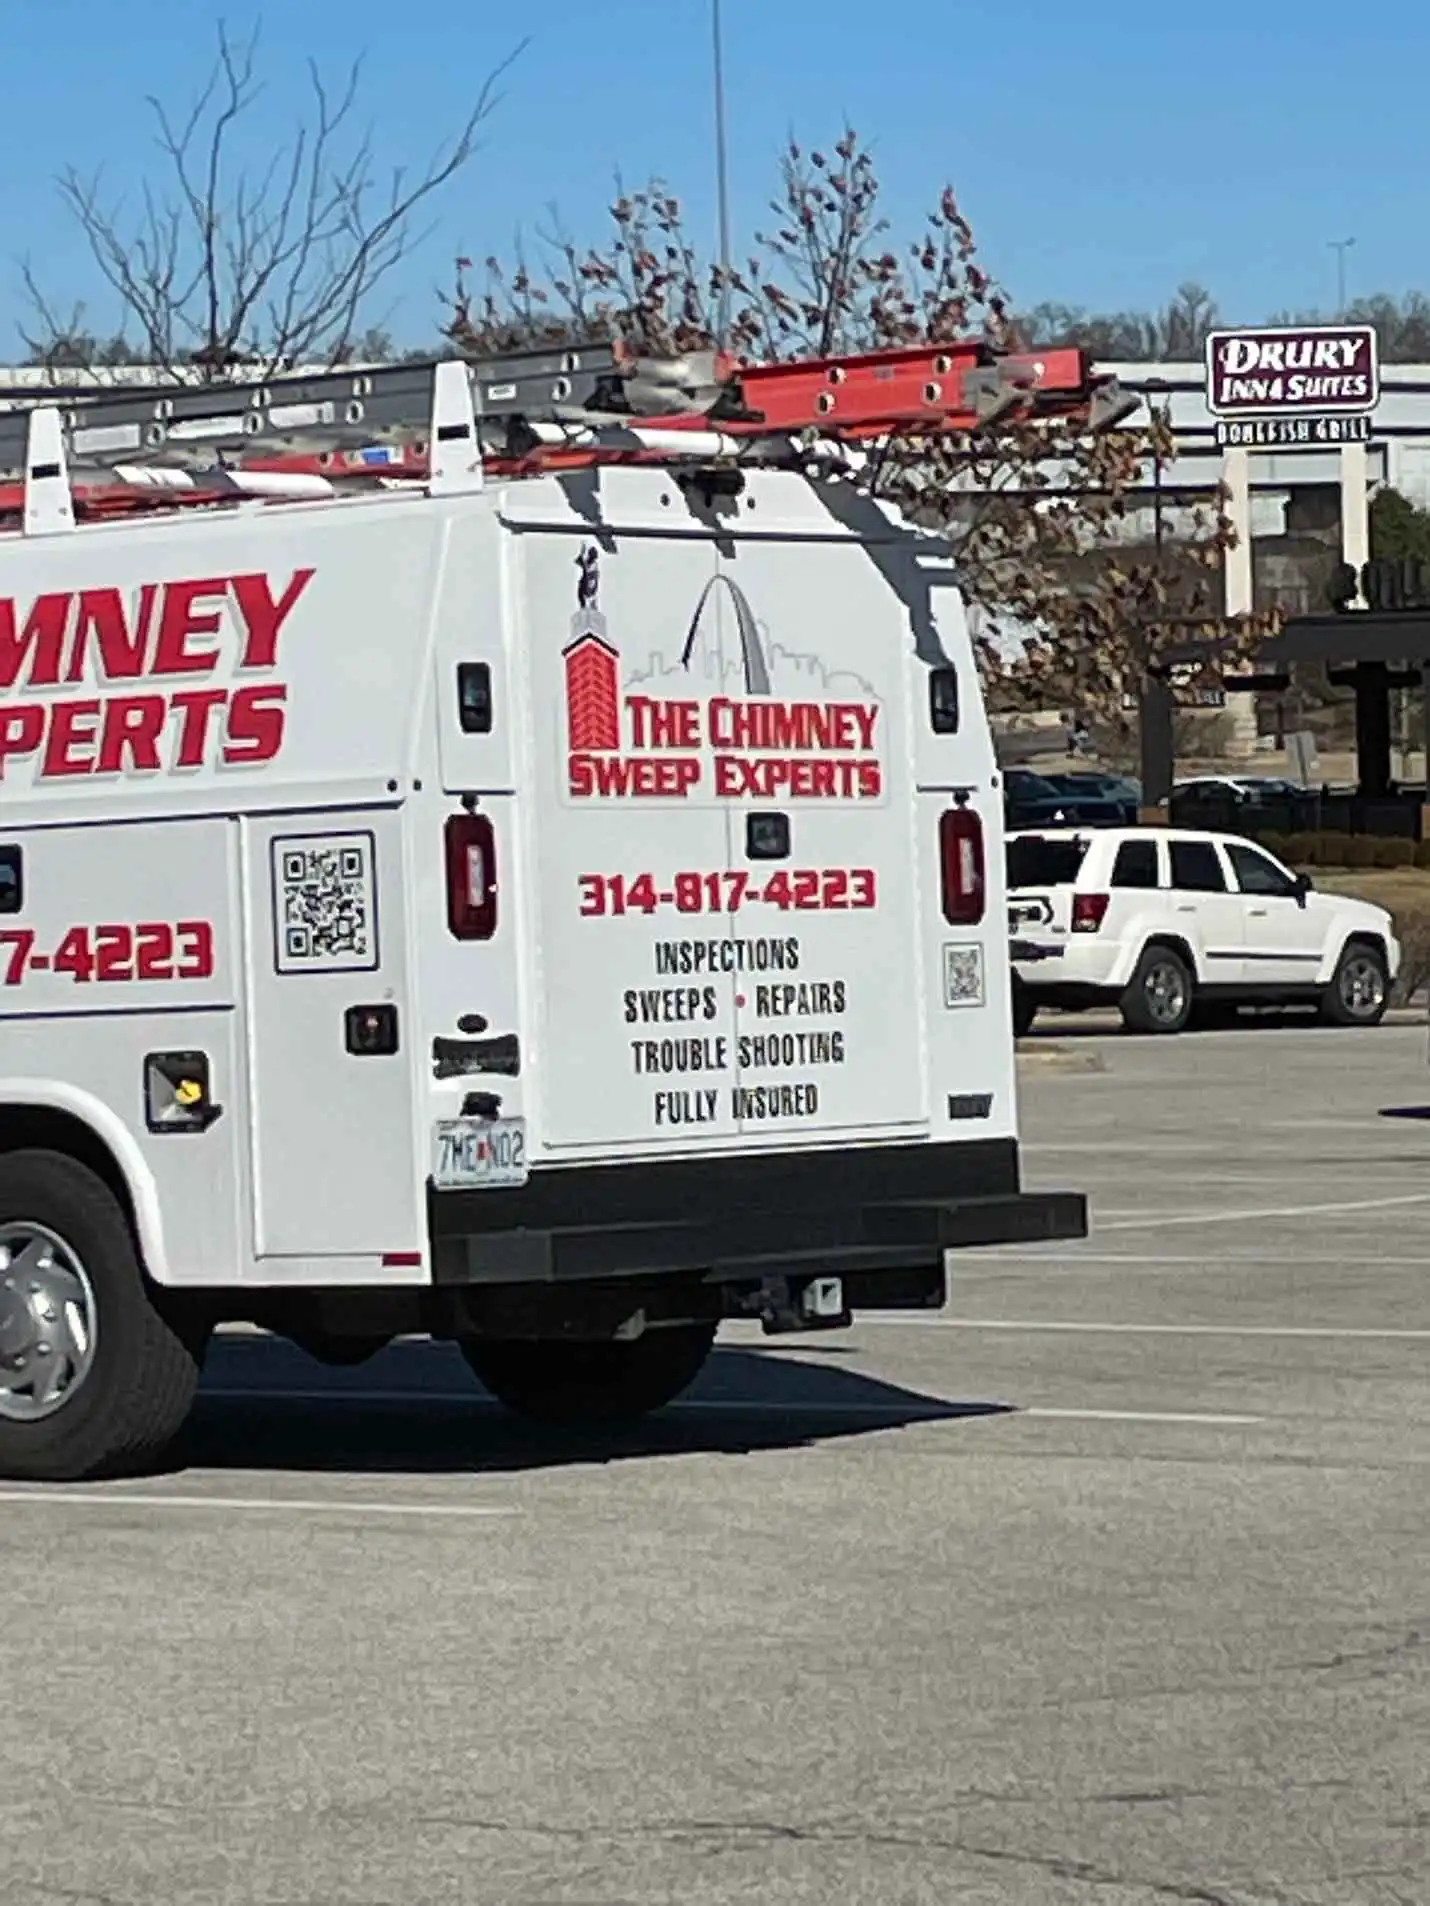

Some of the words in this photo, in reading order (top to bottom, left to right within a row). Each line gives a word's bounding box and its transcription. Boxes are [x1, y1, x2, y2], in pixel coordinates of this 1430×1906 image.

[1217, 338, 1364, 374] DRURY
[1221, 376, 1268, 403] INN
[1285, 374, 1368, 400] SUITES
[1316, 417, 1370, 440] GRILL
[0, 568, 316, 688] MNEY
[0, 684, 287, 779] PERTS
[626, 696, 702, 748] THE
[708, 697, 879, 750] CHIMNEY
[568, 754, 702, 797] SWEEP
[714, 755, 880, 797] EXPERTS
[578, 869, 877, 917] 314-817-4223
[0, 921, 213, 985] 7-4223
[655, 937, 799, 974] INSPECTIONS
[624, 986, 717, 1023] SWEEPS
[757, 981, 846, 1018] REPAIRS
[631, 1036, 728, 1074] TROUBLE
[737, 1031, 845, 1068] SHOOTING
[655, 1088, 719, 1125] FULLY
[731, 1083, 819, 1120] INSURED
